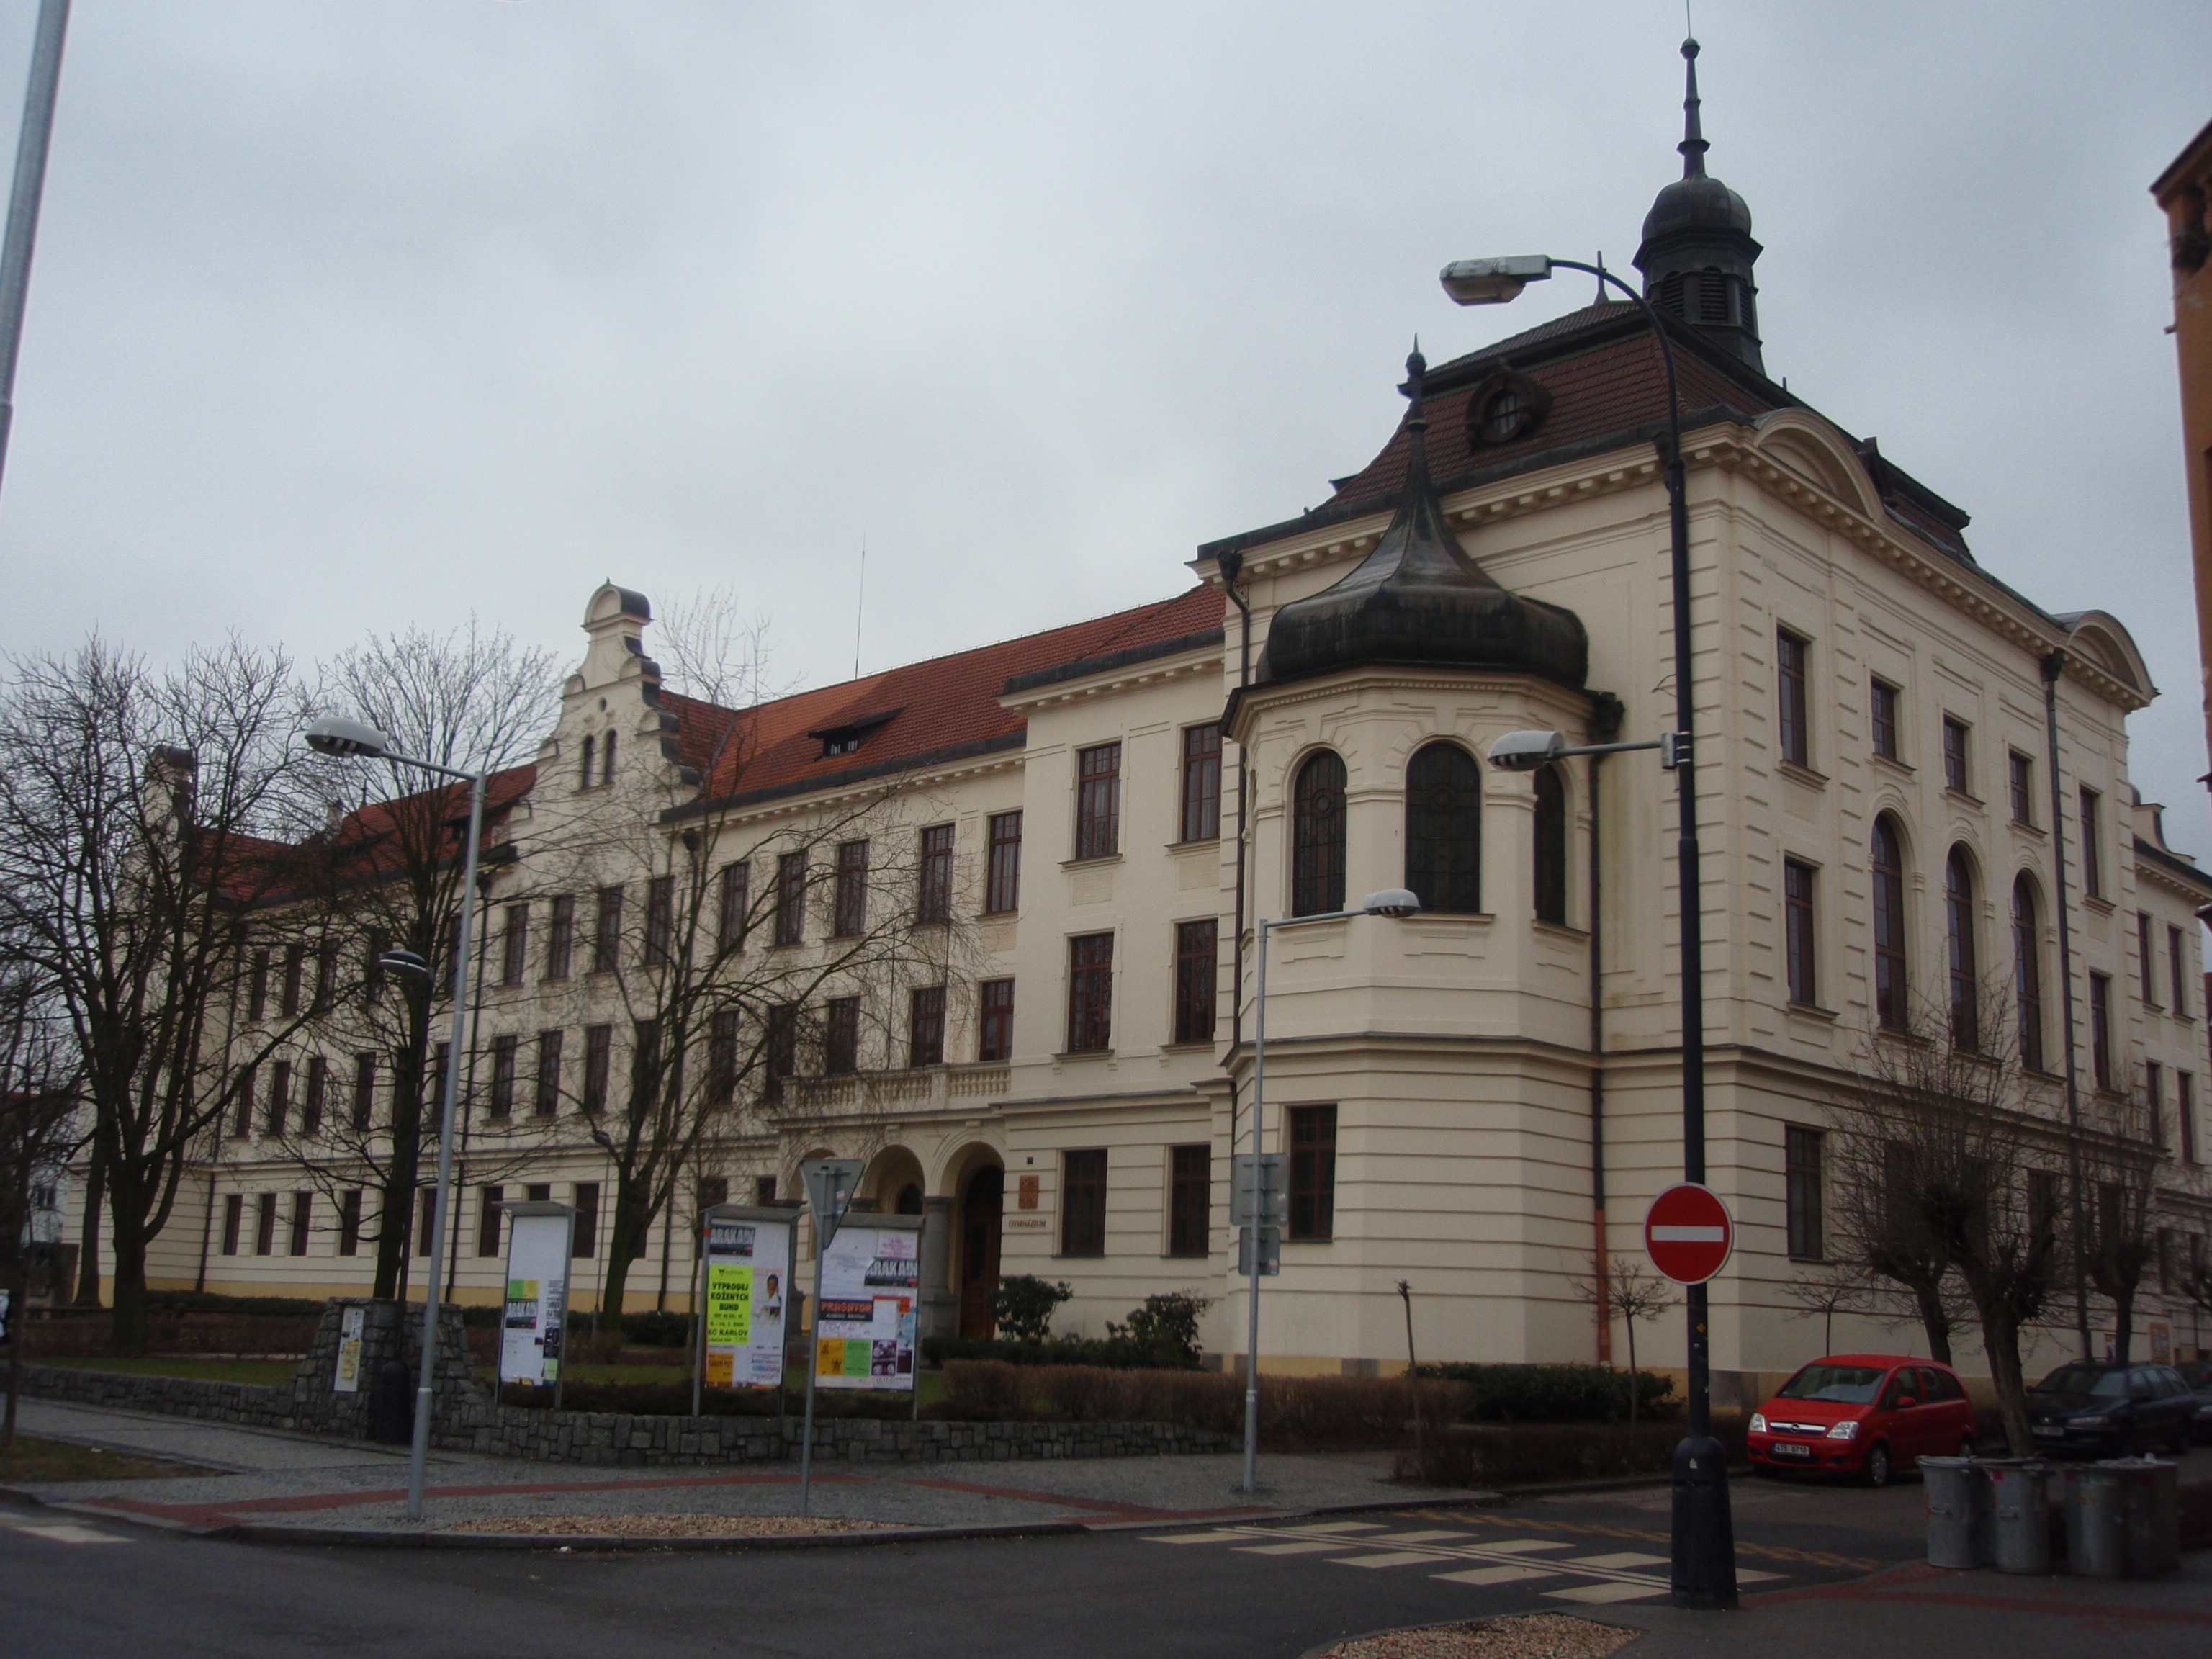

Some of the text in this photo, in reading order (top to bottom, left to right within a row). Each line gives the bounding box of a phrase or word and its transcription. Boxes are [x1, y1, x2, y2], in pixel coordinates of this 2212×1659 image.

[710, 1228, 755, 1245] ARAKAIN
[866, 1260, 917, 1277] ARAKAIN
[507, 1301, 538, 1318] ARAKAIN
